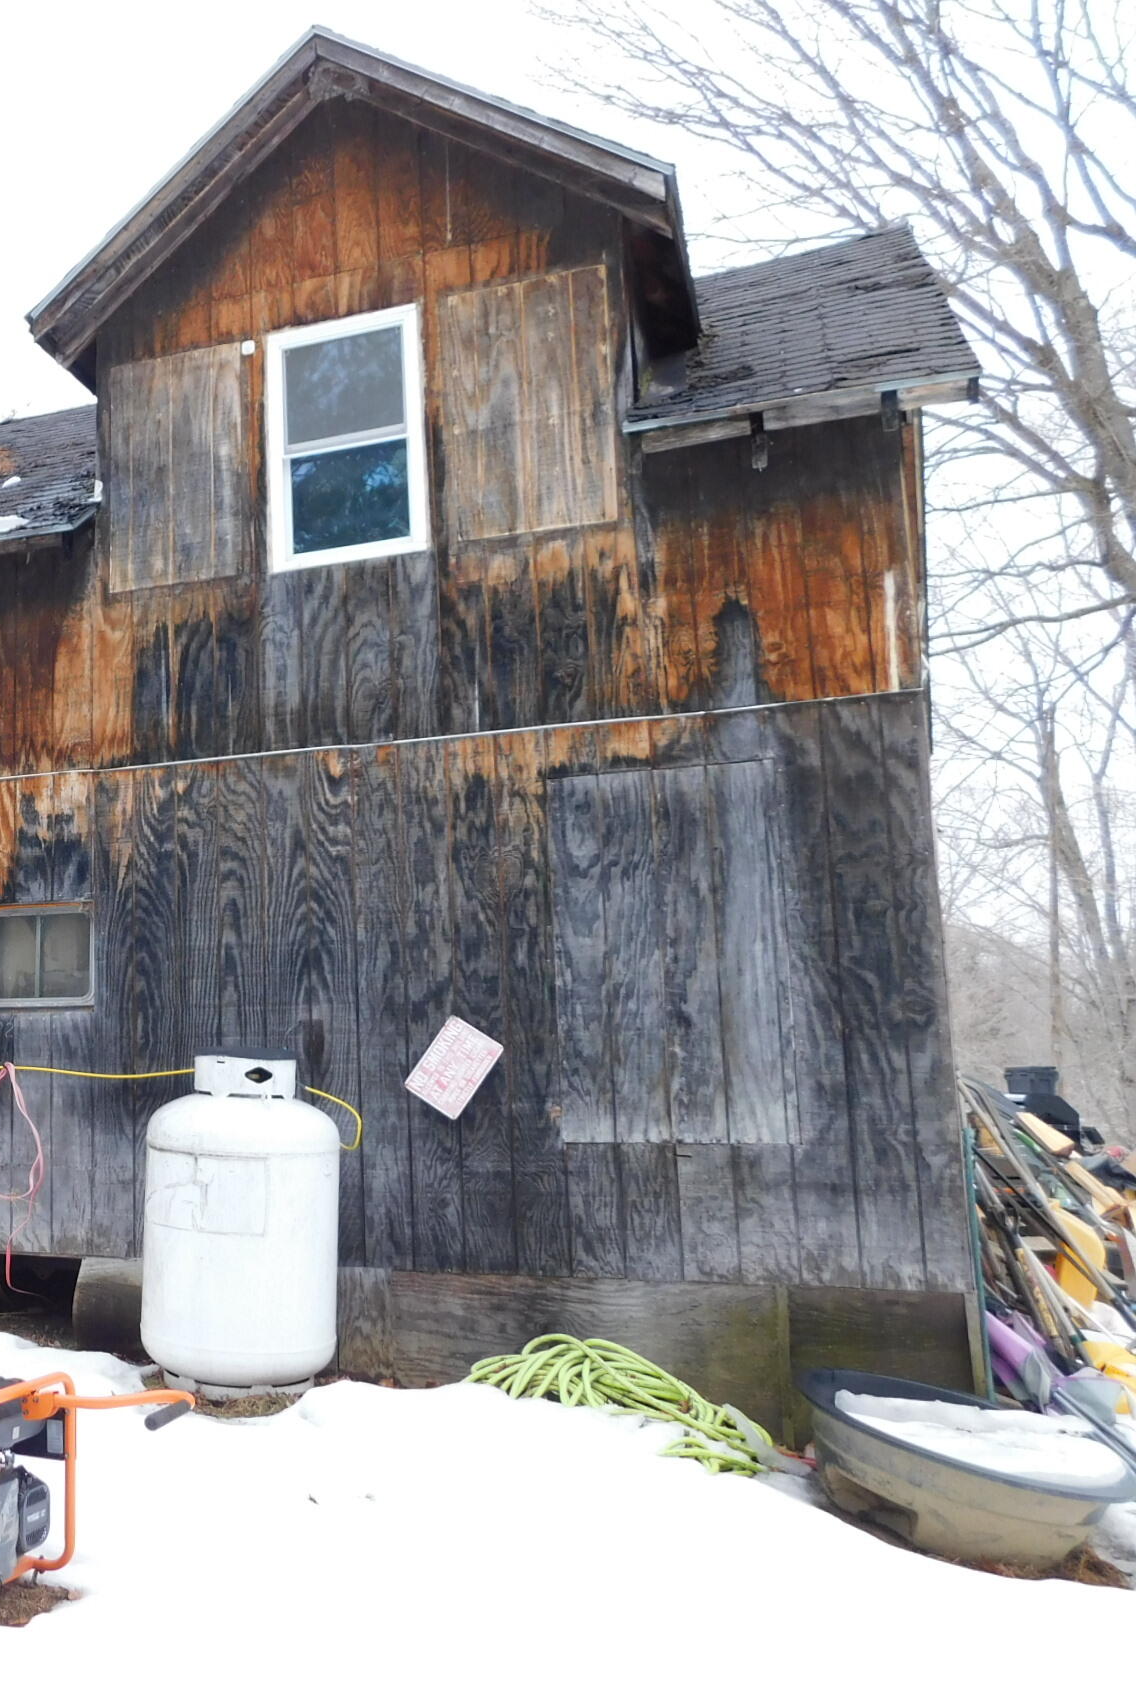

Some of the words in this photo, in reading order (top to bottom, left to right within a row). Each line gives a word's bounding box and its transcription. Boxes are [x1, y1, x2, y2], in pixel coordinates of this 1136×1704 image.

[410, 1070, 429, 1091] NO
[423, 1019, 463, 1071] SMOKING
[429, 1083, 444, 1100] AT
[439, 1060, 458, 1086] ANY
[457, 1033, 479, 1060] TIME
